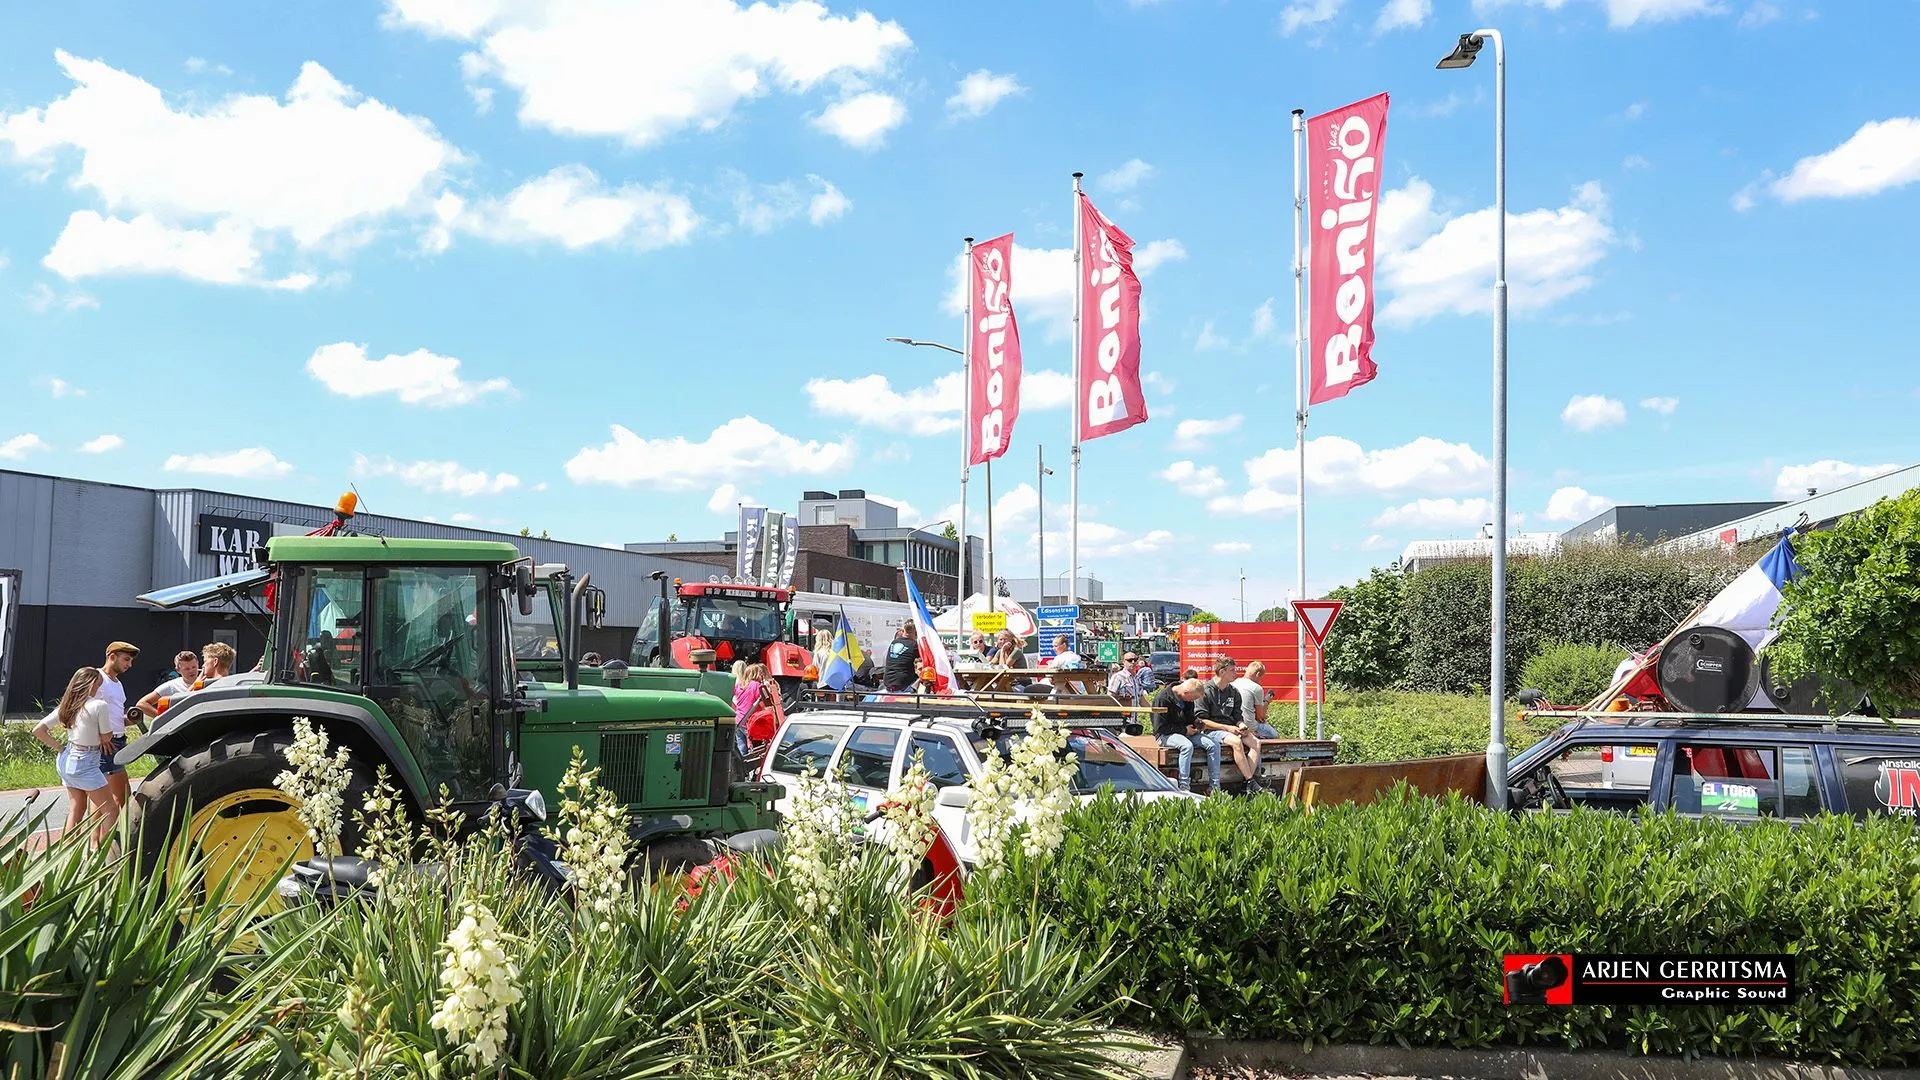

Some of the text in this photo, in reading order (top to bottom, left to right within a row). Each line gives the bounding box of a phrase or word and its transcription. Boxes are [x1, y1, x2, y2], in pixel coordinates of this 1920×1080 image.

[210, 526, 262, 554] KAR
[1187, 624, 1211, 634] Boni
[666, 733, 682, 744] SE
[1718, 799, 1738, 811] 22
